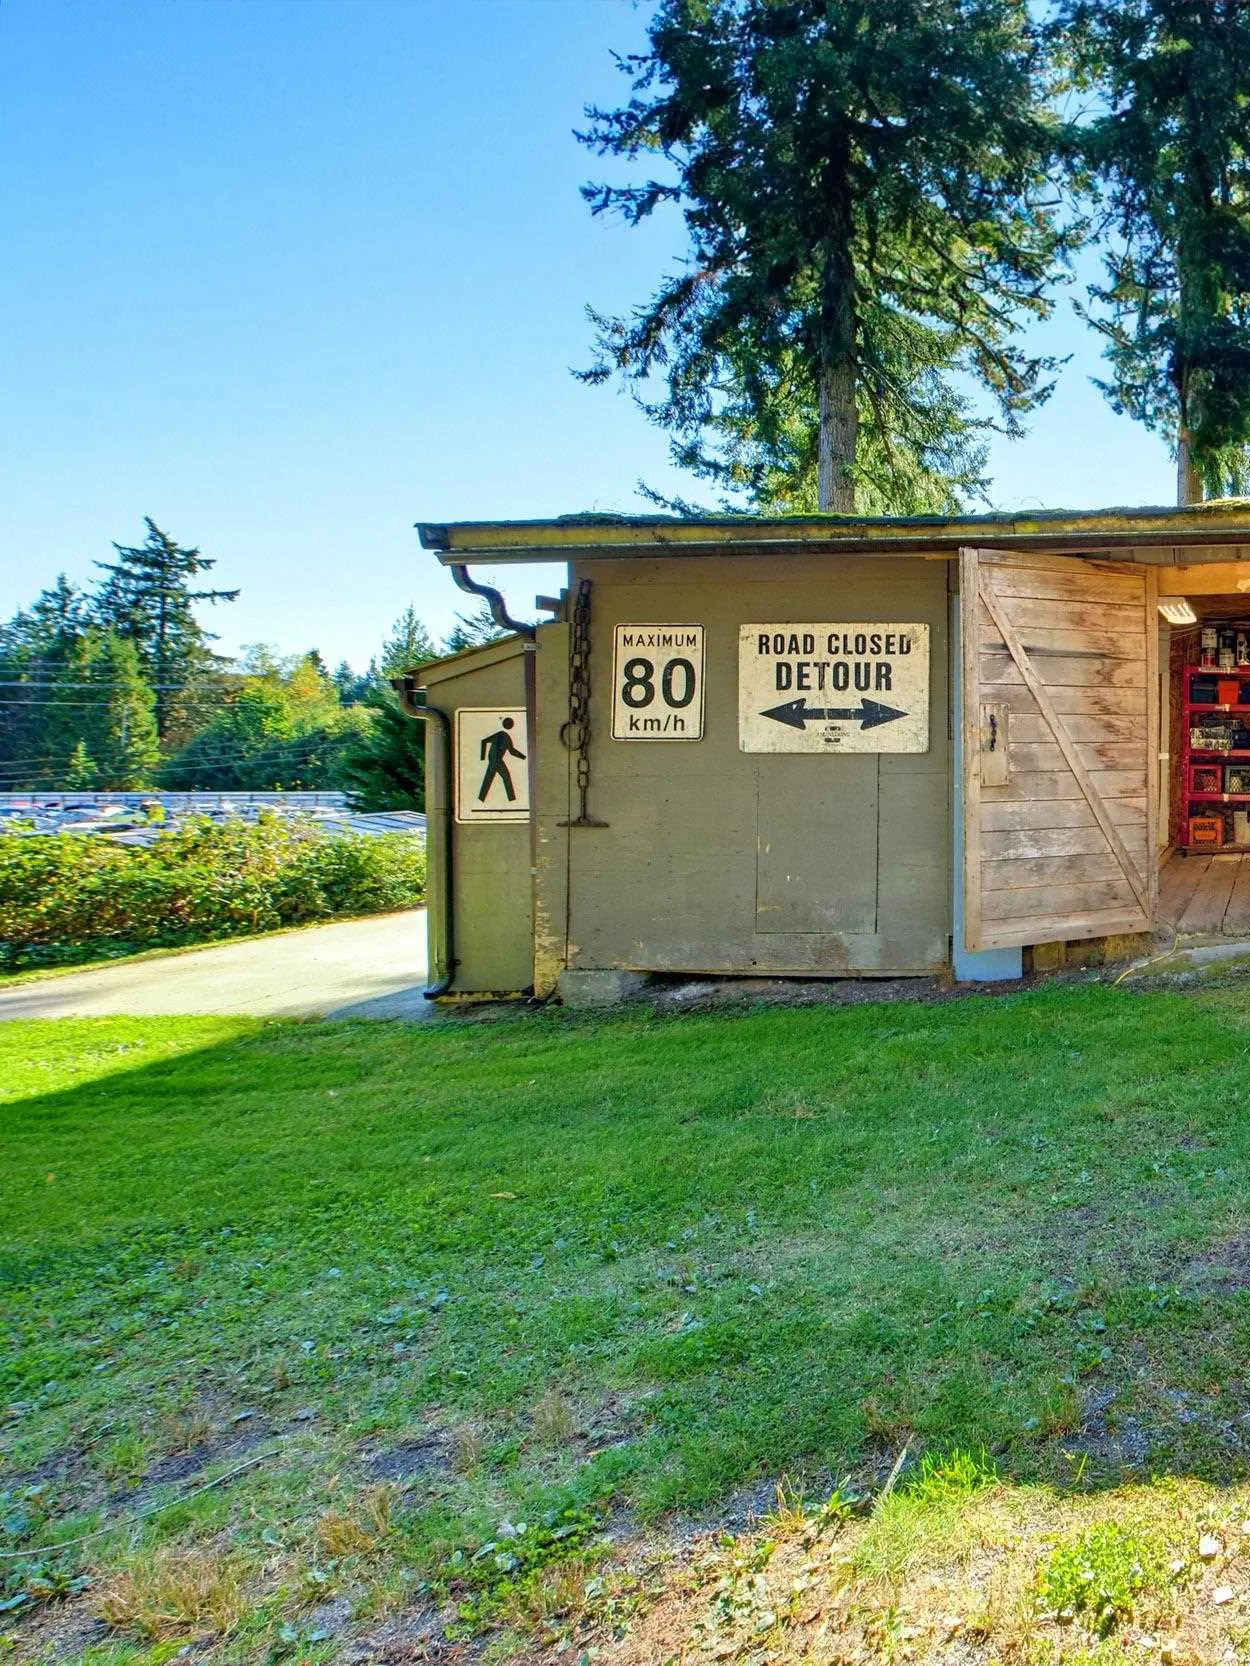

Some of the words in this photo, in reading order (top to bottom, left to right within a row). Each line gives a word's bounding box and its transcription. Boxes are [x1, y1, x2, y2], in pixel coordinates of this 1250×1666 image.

[623, 634, 697, 647] MAXIMUM
[758, 633, 815, 655] ROAD
[827, 633, 912, 655] CLOSED
[622, 657, 696, 709] 80
[775, 661, 892, 691] DETOUR
[629, 714, 685, 732] km/h
